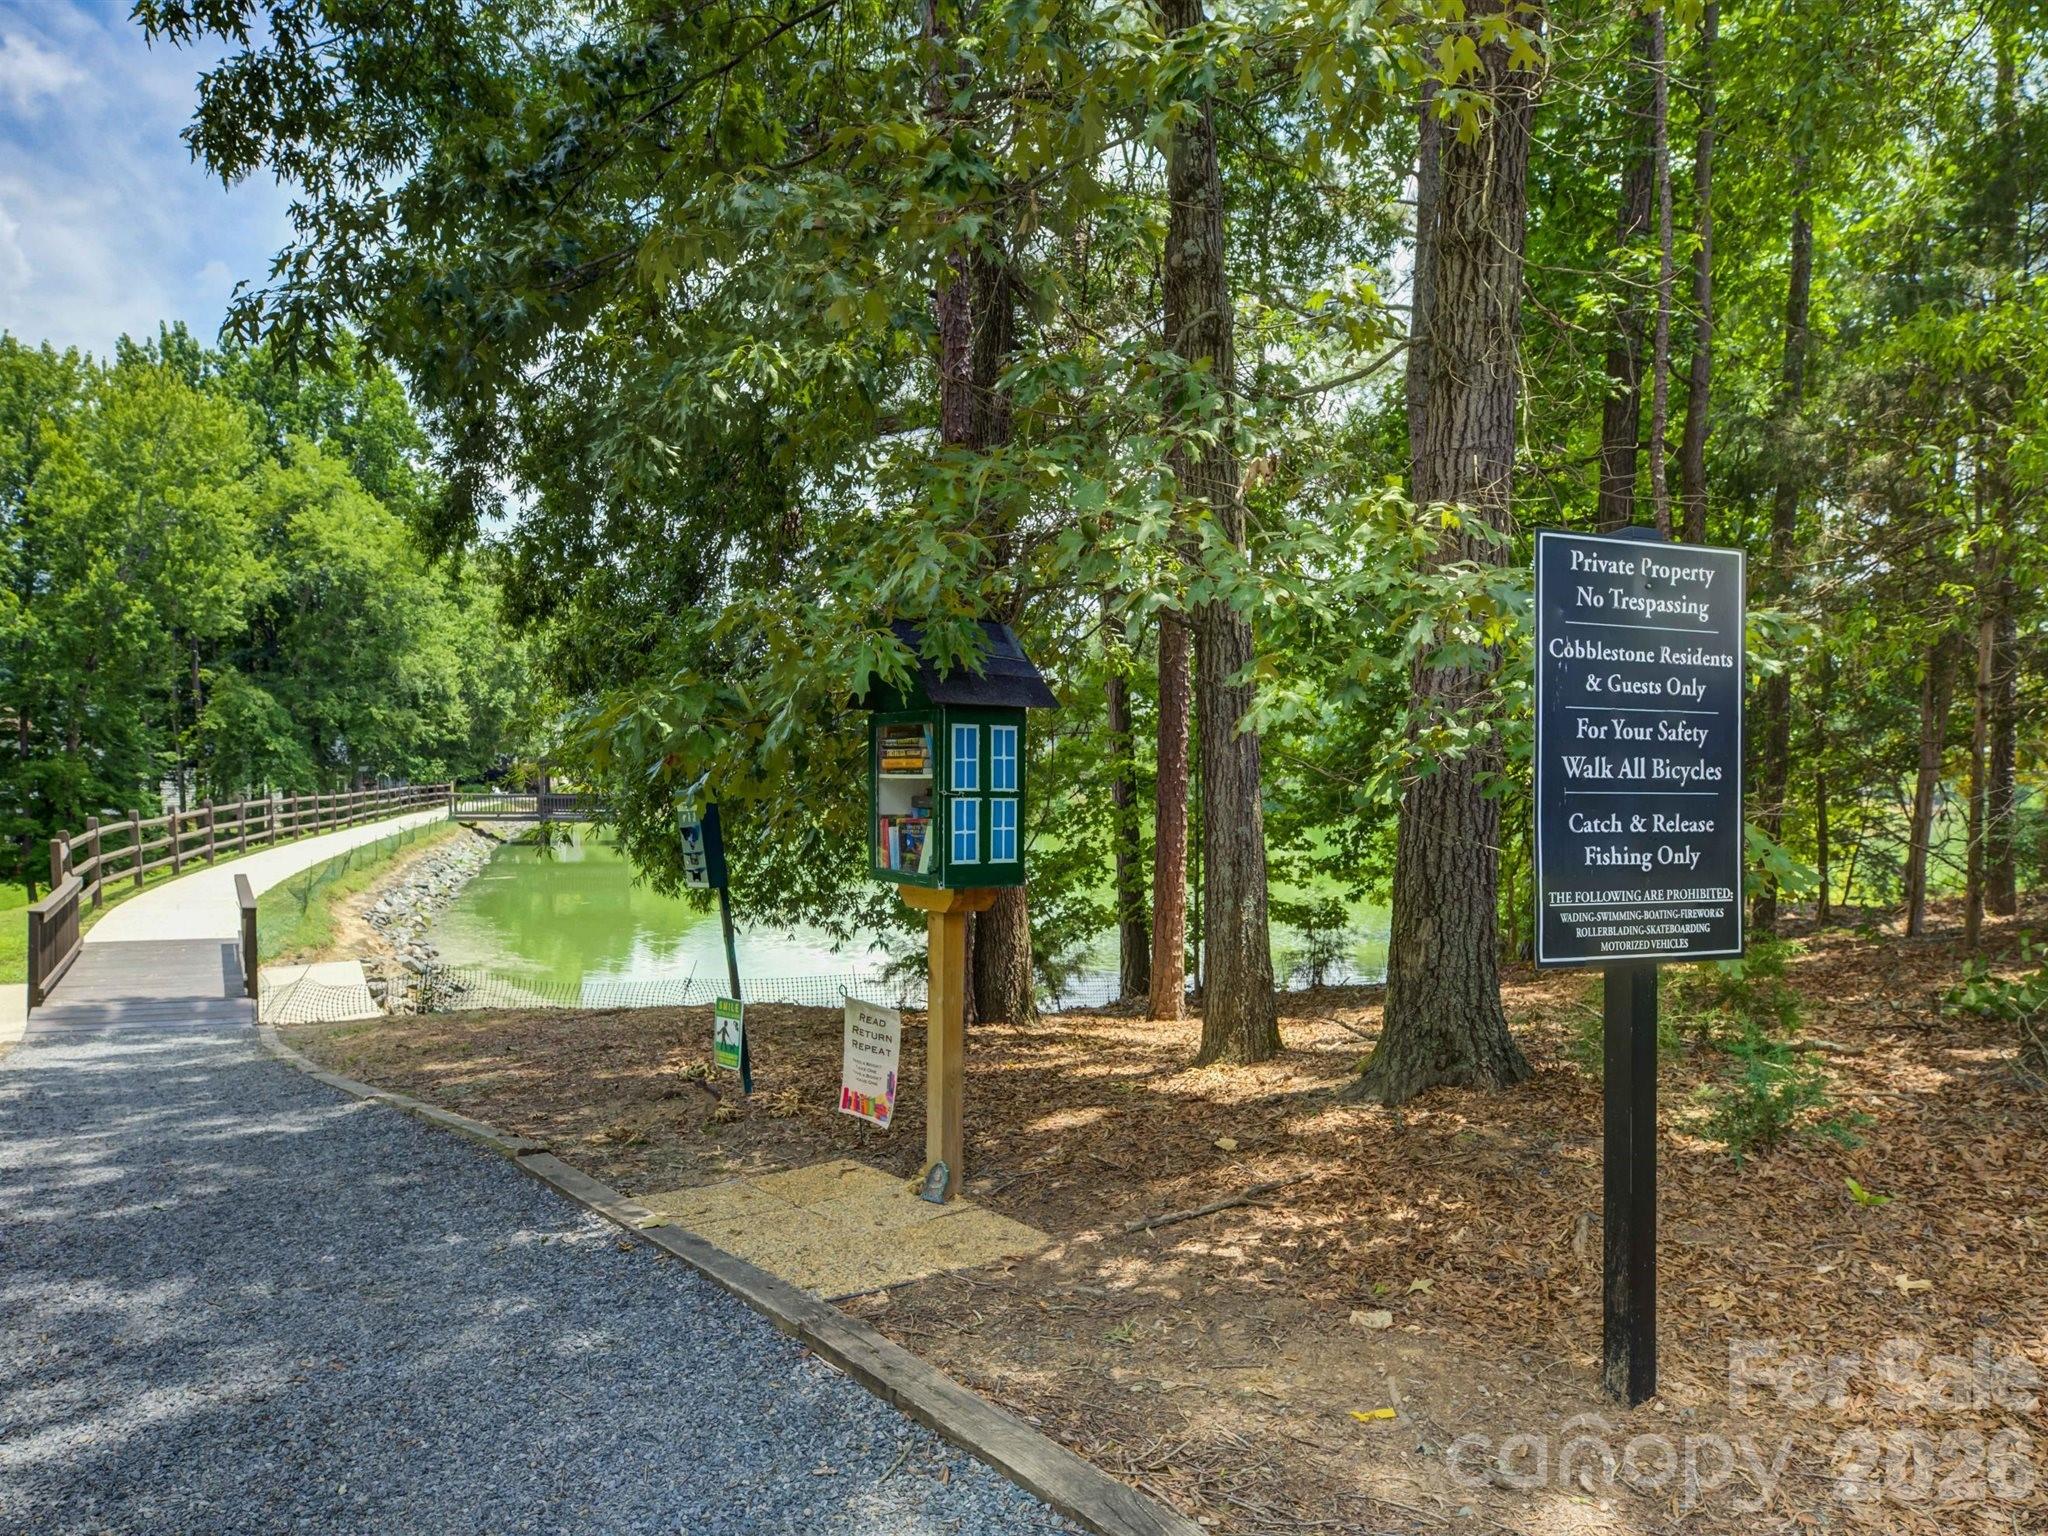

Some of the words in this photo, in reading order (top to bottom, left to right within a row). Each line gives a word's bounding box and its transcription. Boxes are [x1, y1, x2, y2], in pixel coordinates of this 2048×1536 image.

[1570, 550, 1634, 576] Private
[1641, 557, 1716, 588] Property
[1576, 586, 1604, 607] No
[1609, 587, 1710, 622] Trespassing
[1549, 638, 1655, 663] Cobblestone
[1659, 646, 1734, 668] Residents
[1585, 674, 1602, 692] &
[1607, 674, 1662, 695] Guests
[1666, 677, 1706, 702] Only
[1576, 718, 1608, 739] For
[1611, 719, 1653, 741] Your
[1657, 720, 1709, 748] Safety
[1561, 755, 1614, 779] Walk
[1618, 757, 1646, 780] All
[1651, 758, 1722, 787] Bicycles
[1568, 813, 1623, 833] Catch
[1629, 814, 1647, 833] &
[1652, 813, 1715, 833] Release
[1584, 845, 1653, 872] Fishing
[1657, 845, 1701, 870] Only
[1549, 891, 1573, 904] THE
[1575, 890, 1642, 903] FOLLOWING
[1644, 889, 1665, 901] ARE
[1666, 887, 1734, 901] PROHIBITED:
[1600, 939, 1650, 951] MOTORIZED
[1650, 938, 1689, 950] VEHICLES
[859, 1013, 886, 1027] READ
[852, 1025, 892, 1043] RETURN
[851, 1039, 891, 1057] REPEAT
